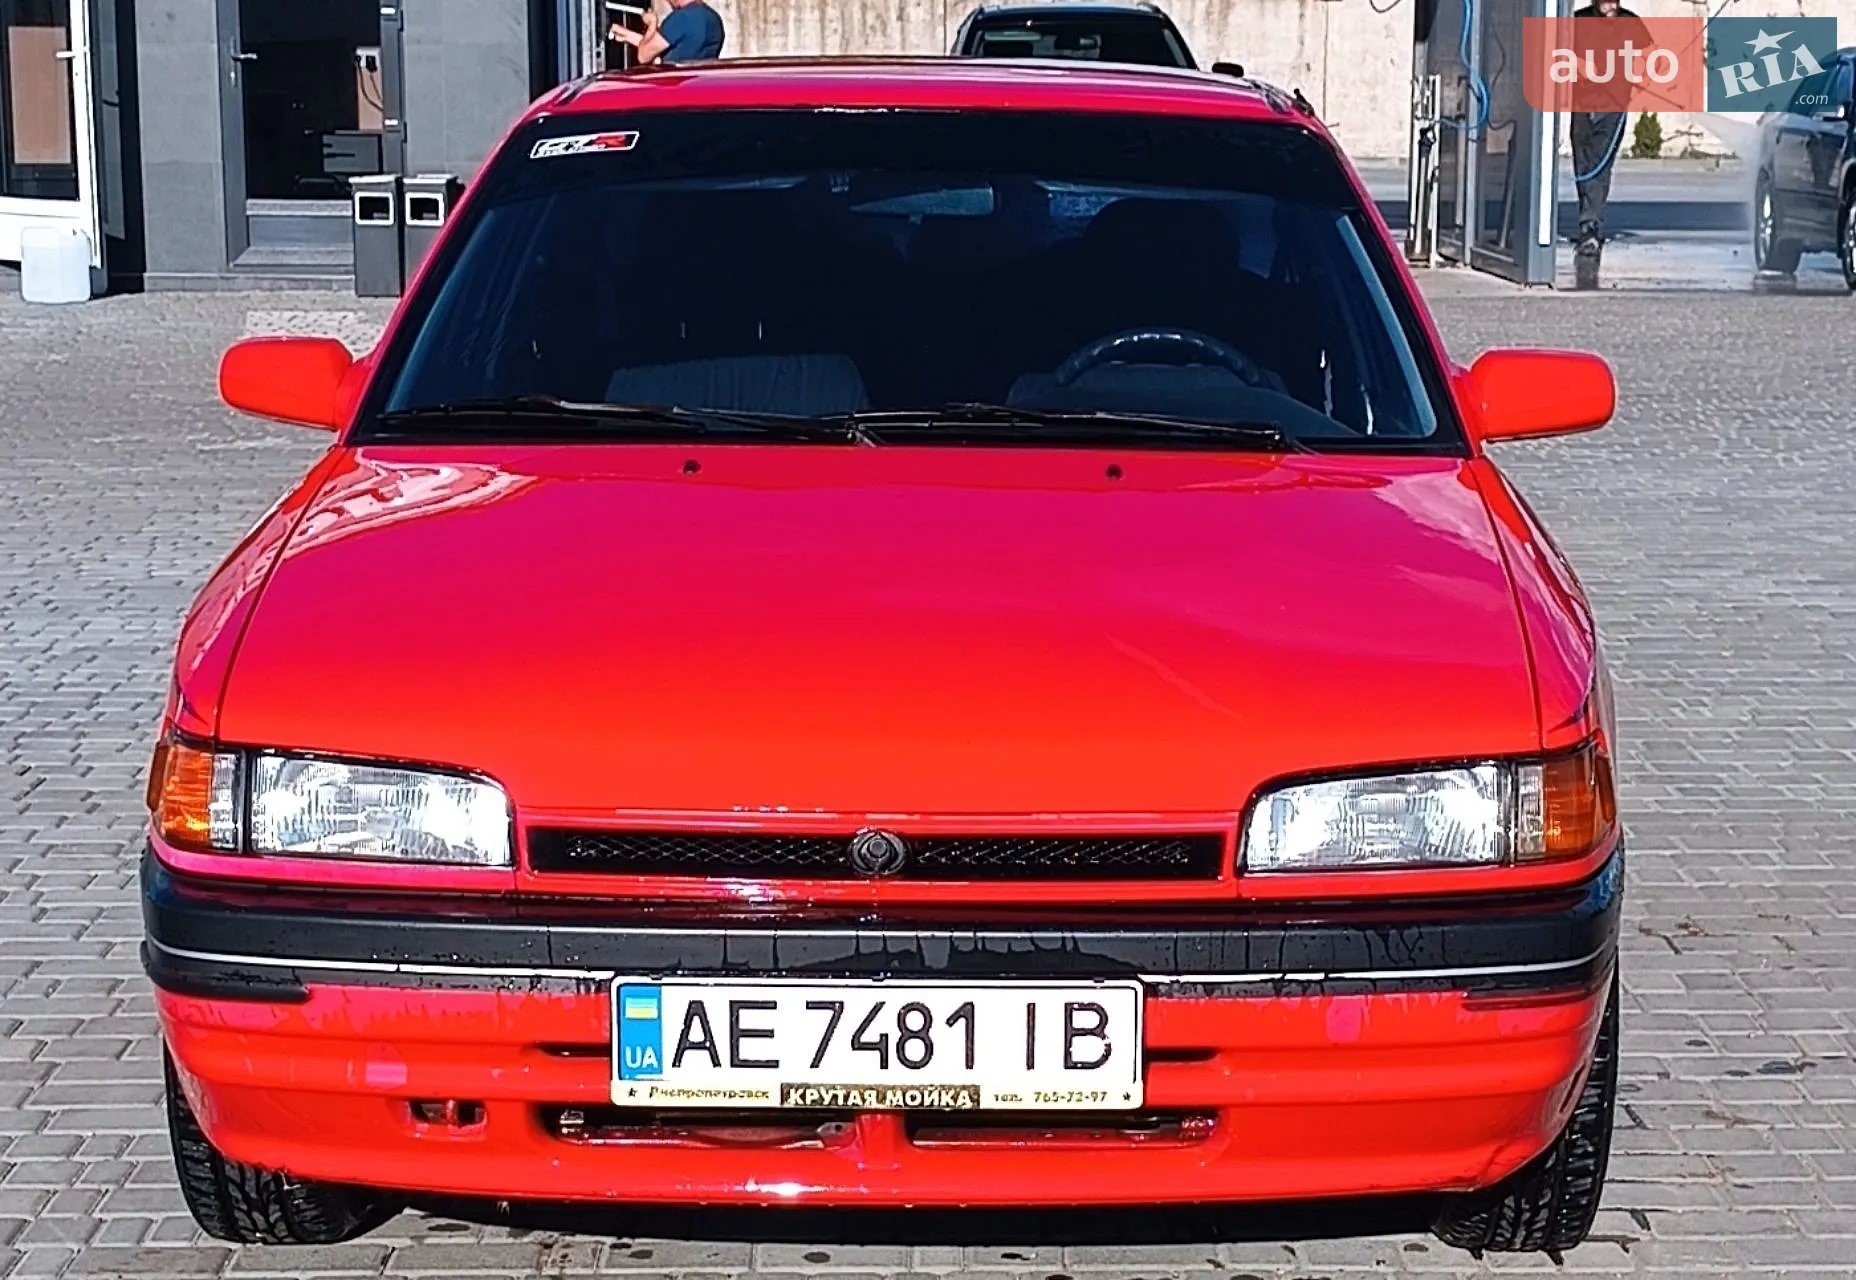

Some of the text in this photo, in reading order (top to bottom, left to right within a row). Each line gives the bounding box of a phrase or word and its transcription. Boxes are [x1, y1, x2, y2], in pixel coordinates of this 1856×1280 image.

[672, 1000, 1113, 1071] AE 7481 IB
[625, 1046, 659, 1069] UA
[785, 1085, 877, 1106] КРУТАЯ
[886, 1085, 973, 1107] МОЙКА
[1033, 1090, 1108, 1103] 765-72-97
